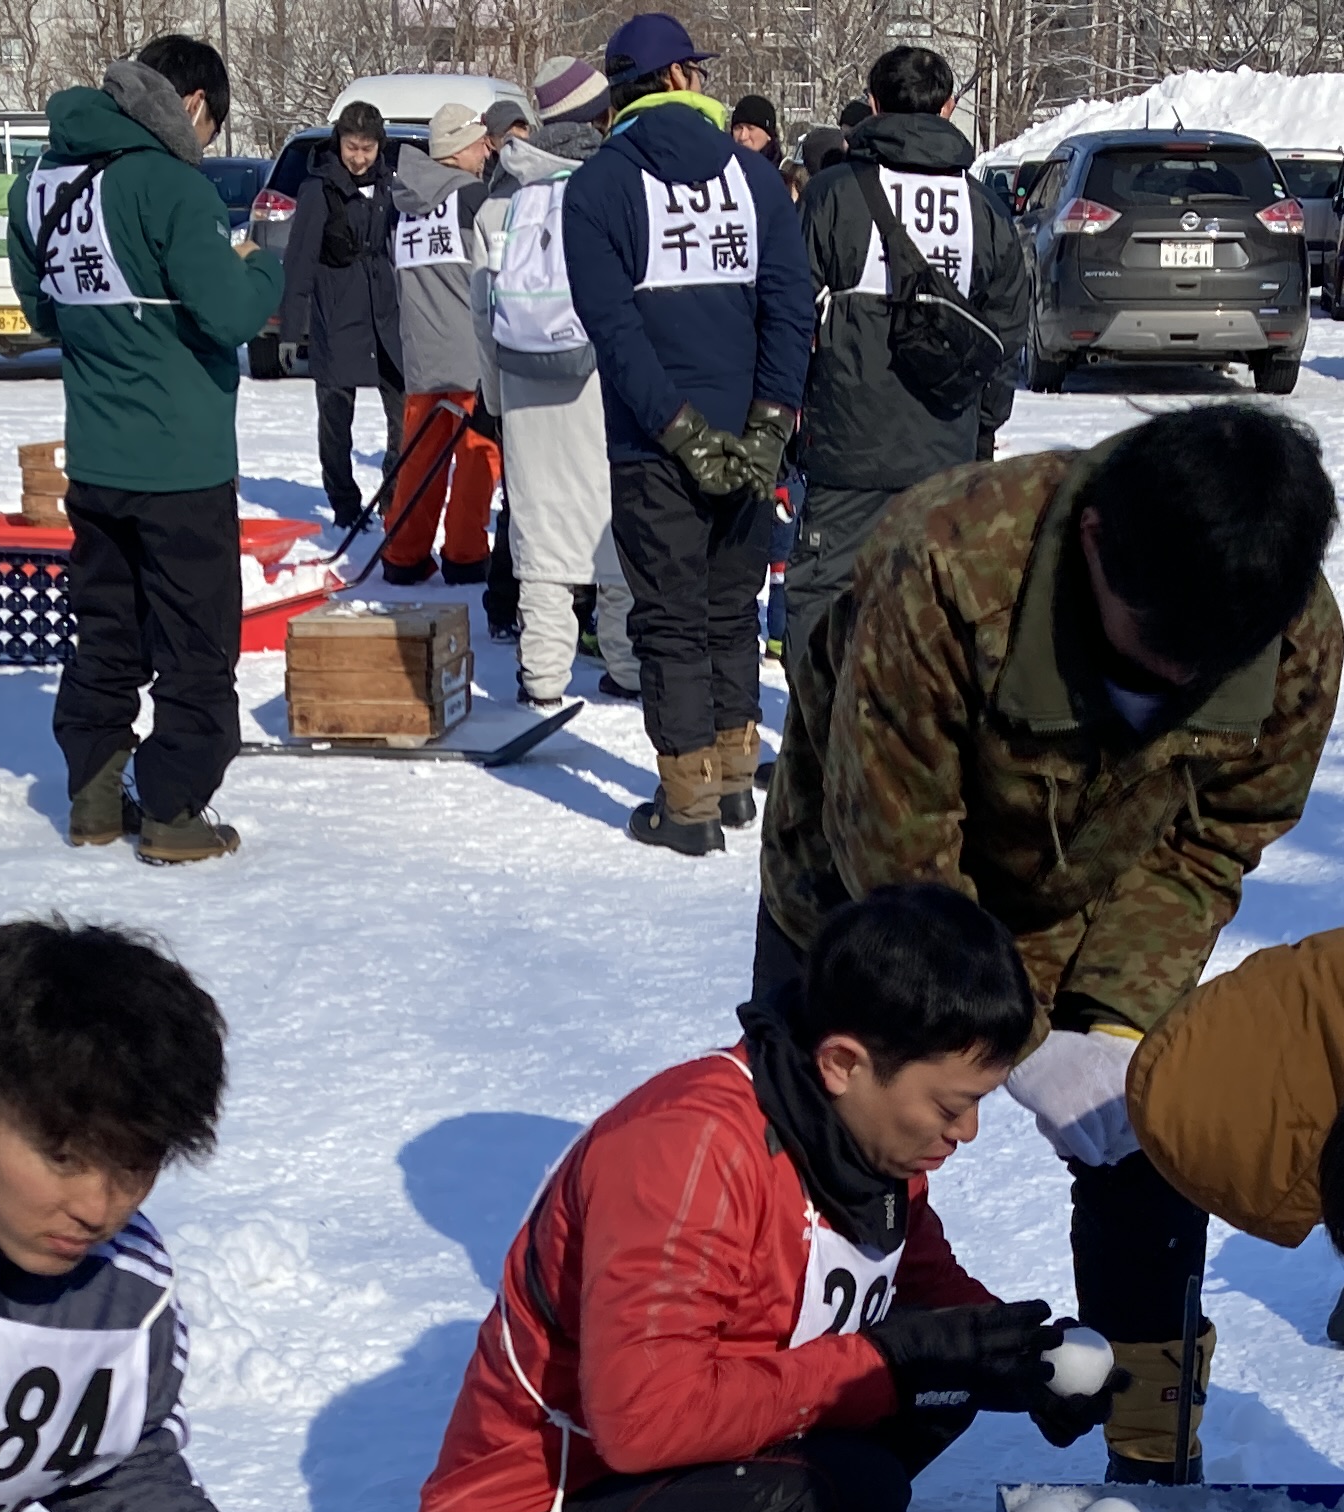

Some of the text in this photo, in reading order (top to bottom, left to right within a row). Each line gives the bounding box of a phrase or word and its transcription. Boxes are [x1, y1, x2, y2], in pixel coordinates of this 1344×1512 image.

[890, 183, 959, 236] 195
[401, 226, 453, 258] 千歳
[661, 221, 749, 272] 千歳
[1174, 250, 1208, 265] 16-41
